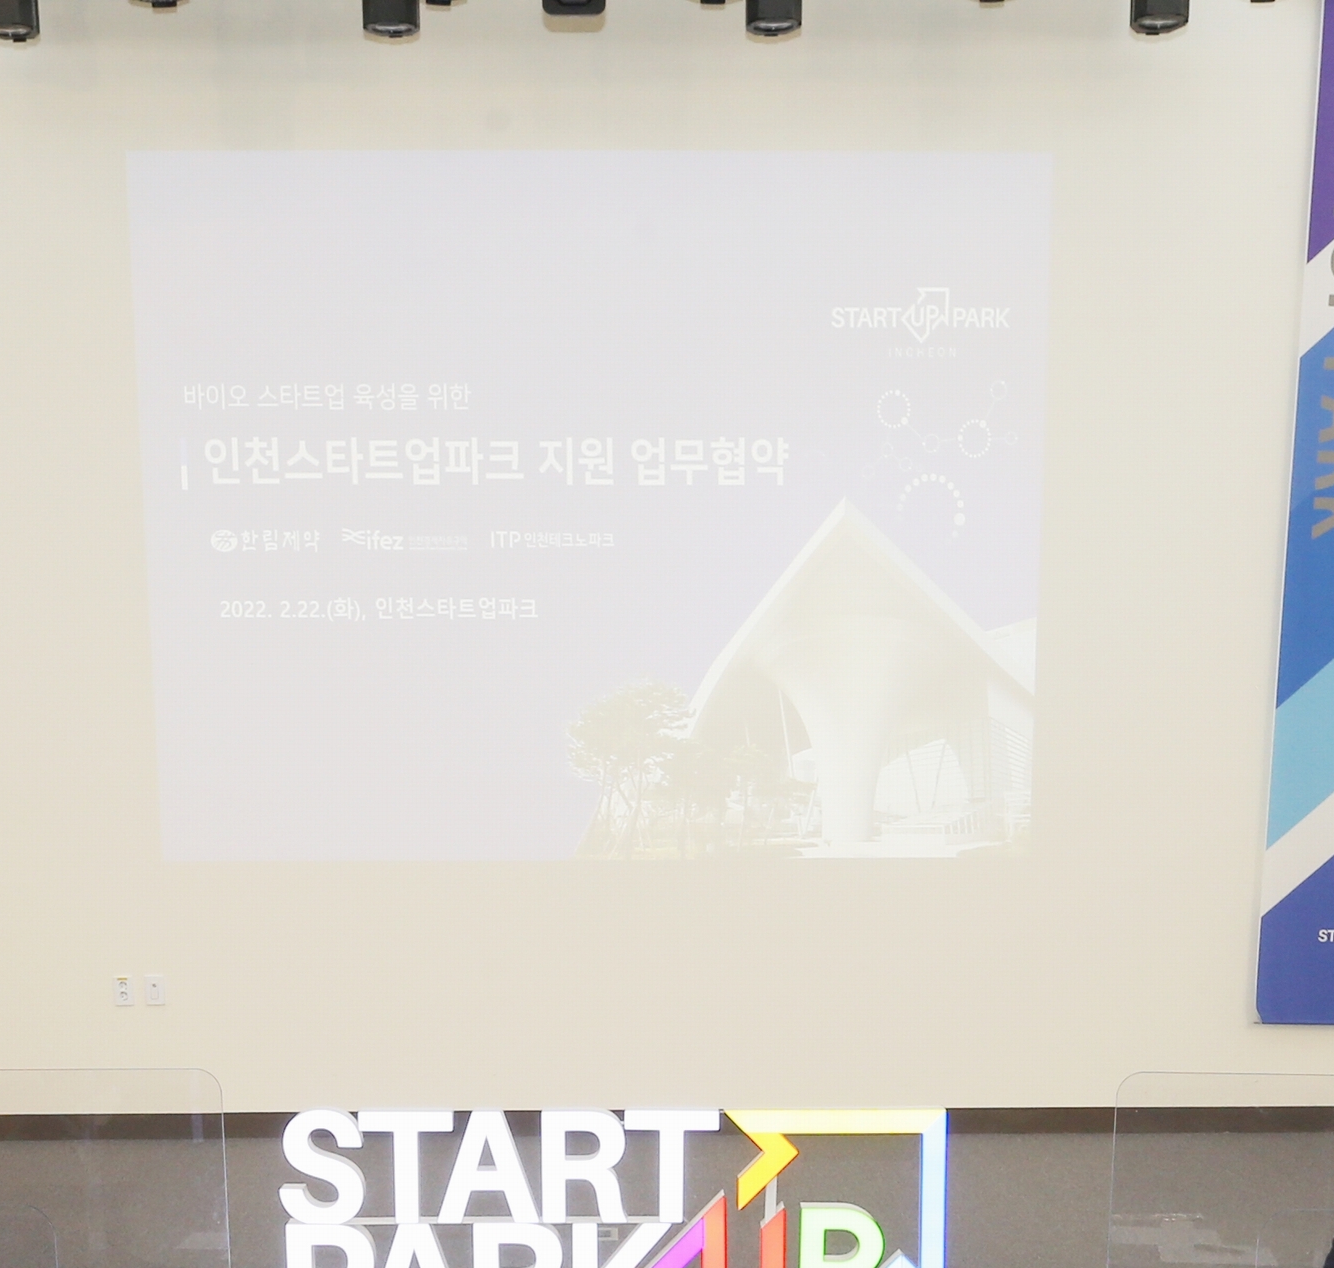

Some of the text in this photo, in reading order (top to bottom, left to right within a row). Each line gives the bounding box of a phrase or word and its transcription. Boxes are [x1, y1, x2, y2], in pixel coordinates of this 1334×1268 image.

[831, 306, 902, 329] START
[953, 306, 1011, 329] PARK
[888, 346, 957, 359] INCHEON
[183, 383, 472, 411] 바이오 스타트업 육성을 위한
[204, 436, 790, 486] 인천스타트업파크 지원 업무협약
[241, 528, 321, 553] 한림제약
[366, 529, 404, 551] ifez
[491, 530, 615, 549] ITP 인천테크노파크
[220, 597, 539, 621] 2022. 2.22.(화), 인천스타트업파크
[277, 1107, 722, 1225] START
